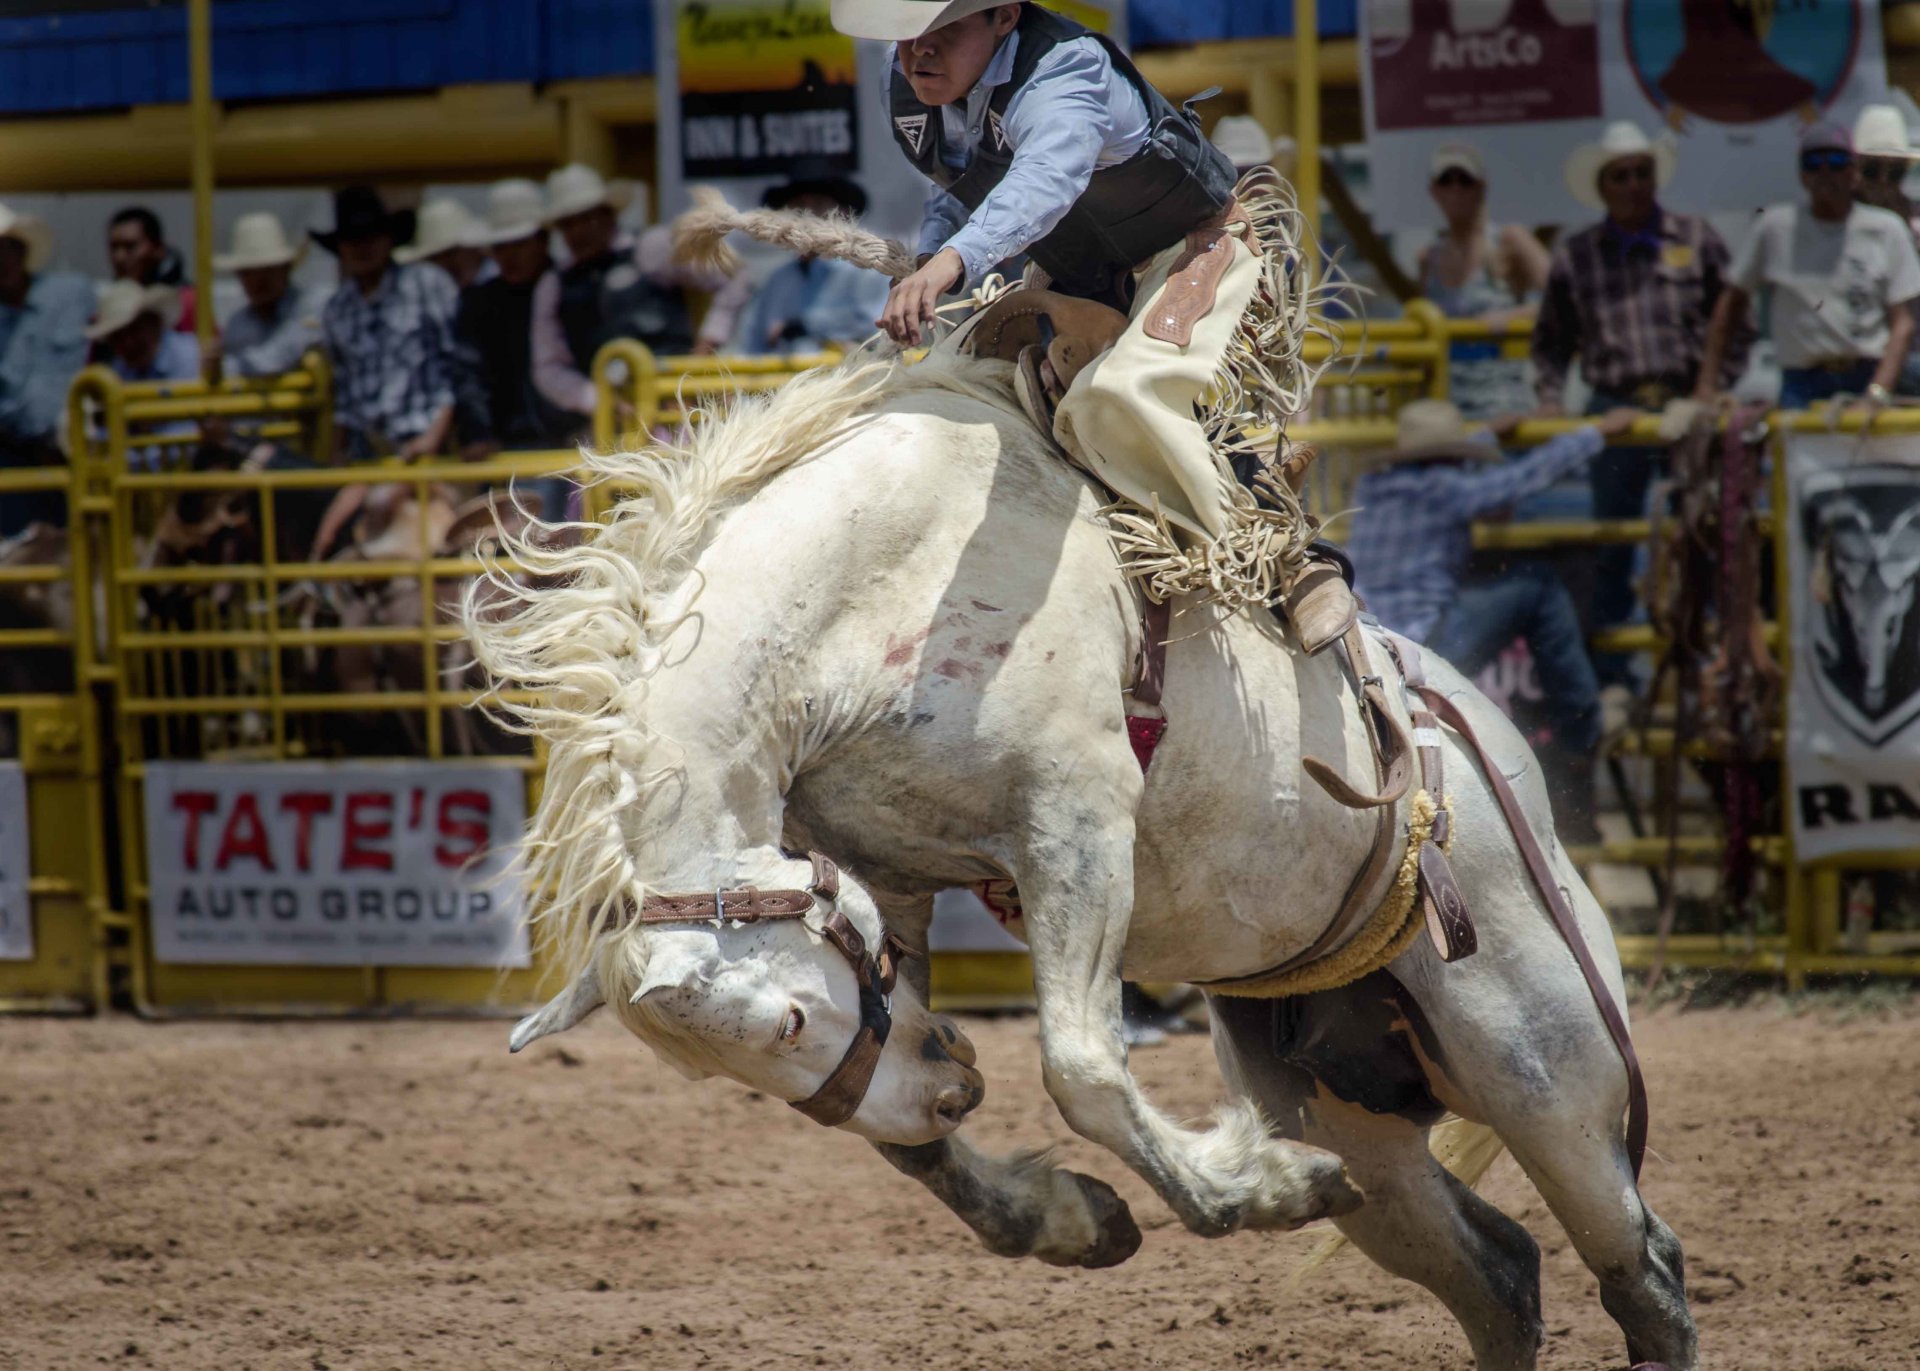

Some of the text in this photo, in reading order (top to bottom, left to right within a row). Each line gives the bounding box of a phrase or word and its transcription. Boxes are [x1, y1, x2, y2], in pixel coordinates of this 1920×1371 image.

[1430, 27, 1542, 70] ArtsCo
[762, 109, 851, 156] SUITES
[1799, 783, 1920, 829] RA
[172, 788, 493, 873] TATE'S
[177, 888, 492, 921] AUTO GROUP
